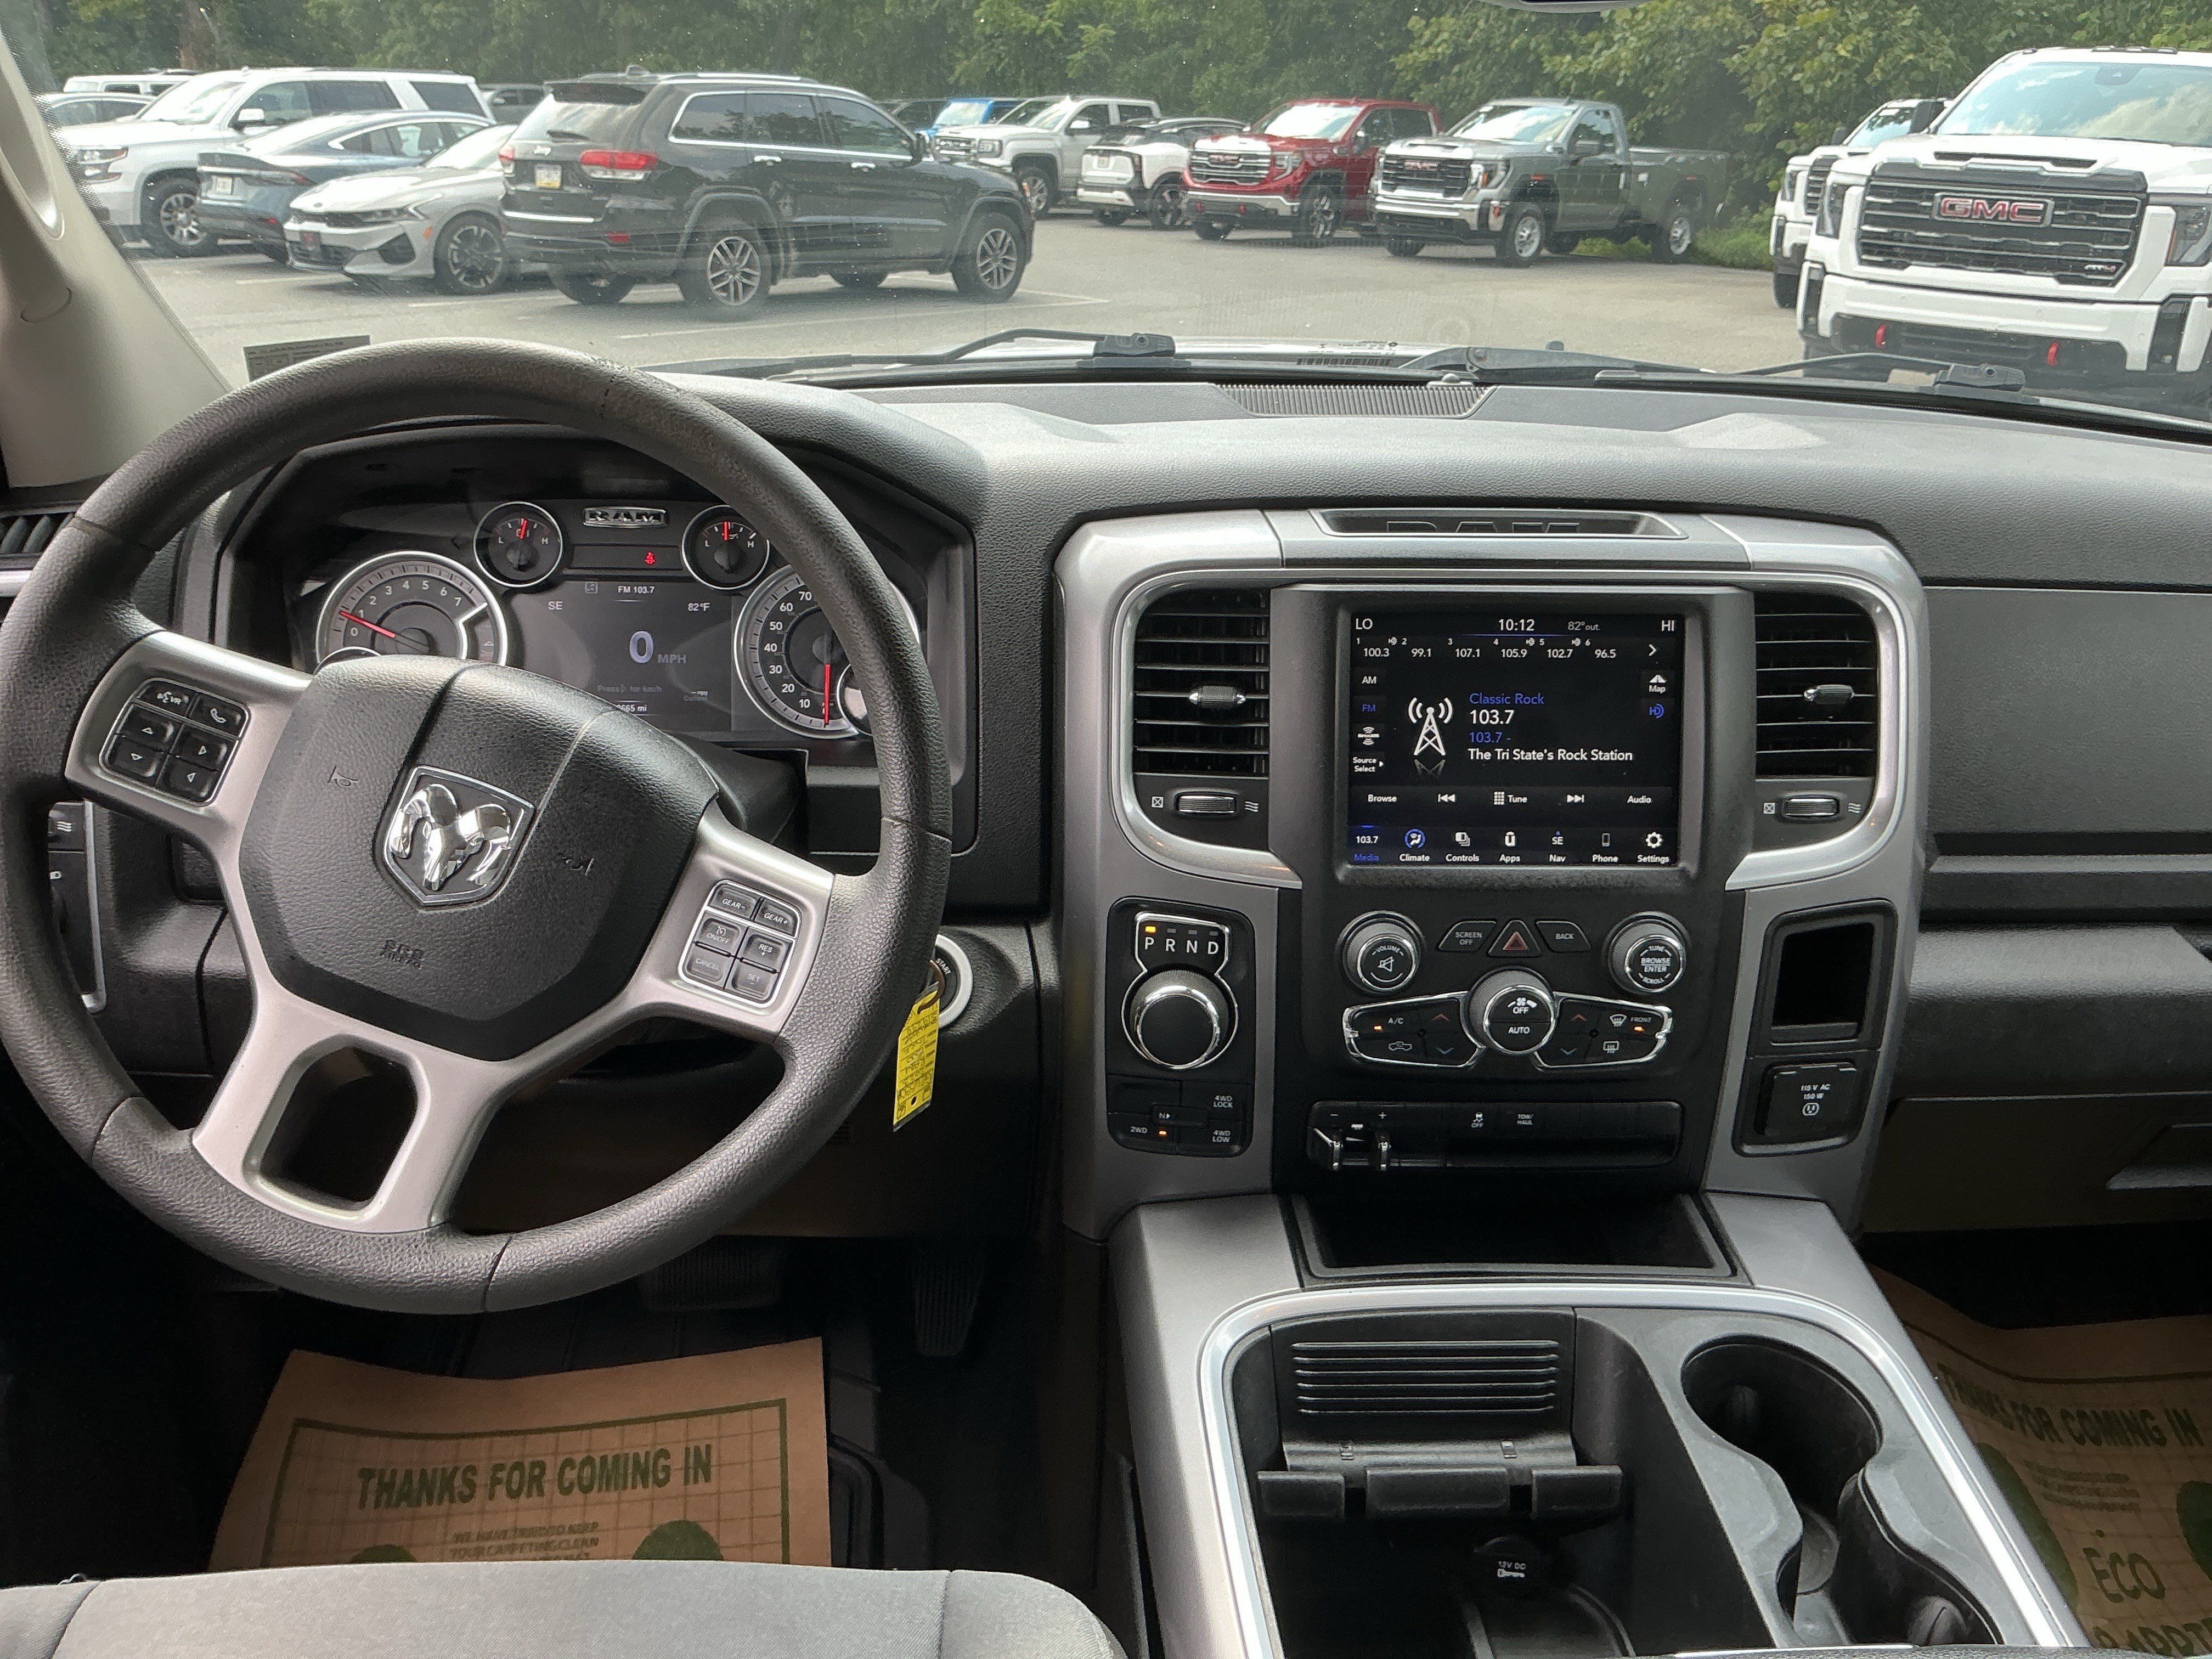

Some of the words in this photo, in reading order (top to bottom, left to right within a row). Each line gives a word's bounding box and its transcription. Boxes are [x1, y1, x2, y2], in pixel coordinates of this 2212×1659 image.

[1940, 197, 2044, 222] GMC
[585, 509, 663, 523] RAM
[541, 537, 549, 545] H
[385, 585, 392, 595] 3
[403, 580, 410, 590] 4
[422, 580, 430, 590] 5
[440, 586, 448, 596] 6
[798, 591, 812, 601] 70
[370, 595, 377, 605] 2
[454, 597, 462, 606] 7
[548, 601, 563, 610] SE
[687, 602, 710, 612] 82°F
[780, 602, 793, 612] 60
[358, 610, 364, 618] 1
[769, 621, 783, 631] 50
[1356, 618, 1373, 630] LO
[1498, 619, 1535, 631] 10:12
[1661, 620, 1675, 631] HI
[351, 628, 358, 637] 0
[629, 630, 654, 663] 0
[658, 654, 687, 664] MPH
[764, 643, 777, 652] 40
[1363, 648, 1390, 657] 100.3
[1411, 648, 1431, 657] 99.1
[1455, 648, 1480, 657] 107.1
[1500, 648, 1527, 658] 105.9
[1547, 648, 1573, 658] 102.7
[1594, 649, 1617, 658] 96.5
[769, 664, 783, 674] 30
[1362, 676, 1377, 684] AM
[782, 684, 795, 693] 20
[1649, 685, 1666, 693] Map
[799, 698, 810, 708] 10
[1469, 693, 1510, 704] Classic
[1515, 693, 1545, 704] Rock
[1470, 709, 1514, 724] 103.7
[1469, 732, 1503, 743] 103.7
[1468, 748, 1491, 760] The
[1494, 748, 1509, 760] Tri
[1513, 748, 1554, 760] State's
[1558, 748, 1588, 760] Rock
[1591, 749, 1633, 761] Station
[1508, 795, 1528, 803] Tune
[1356, 836, 1379, 844] 103.7
[1551, 836, 1564, 845] SE
[1446, 854, 1480, 862] Controls
[1499, 854, 1521, 864] Apps
[1637, 854, 1669, 864] Settings
[758, 944, 773, 953] RES
[1144, 938, 1155, 950] P
[1165, 940, 1176, 952] R
[1187, 941, 1198, 953] N
[1207, 941, 1219, 955] D
[1375, 945, 1401, 953] VOLUME
[695, 958, 720, 971] CANCEL
[935, 958, 952, 975] START
[747, 973, 760, 982] SET
[2163, 1406, 2204, 1447] IN
[357, 1464, 478, 1510] THANKS
[488, 1460, 547, 1500] FOR
[557, 1448, 672, 1497] COMING
[682, 1443, 713, 1487] IN
[2083, 1546, 2166, 1602] ECO
